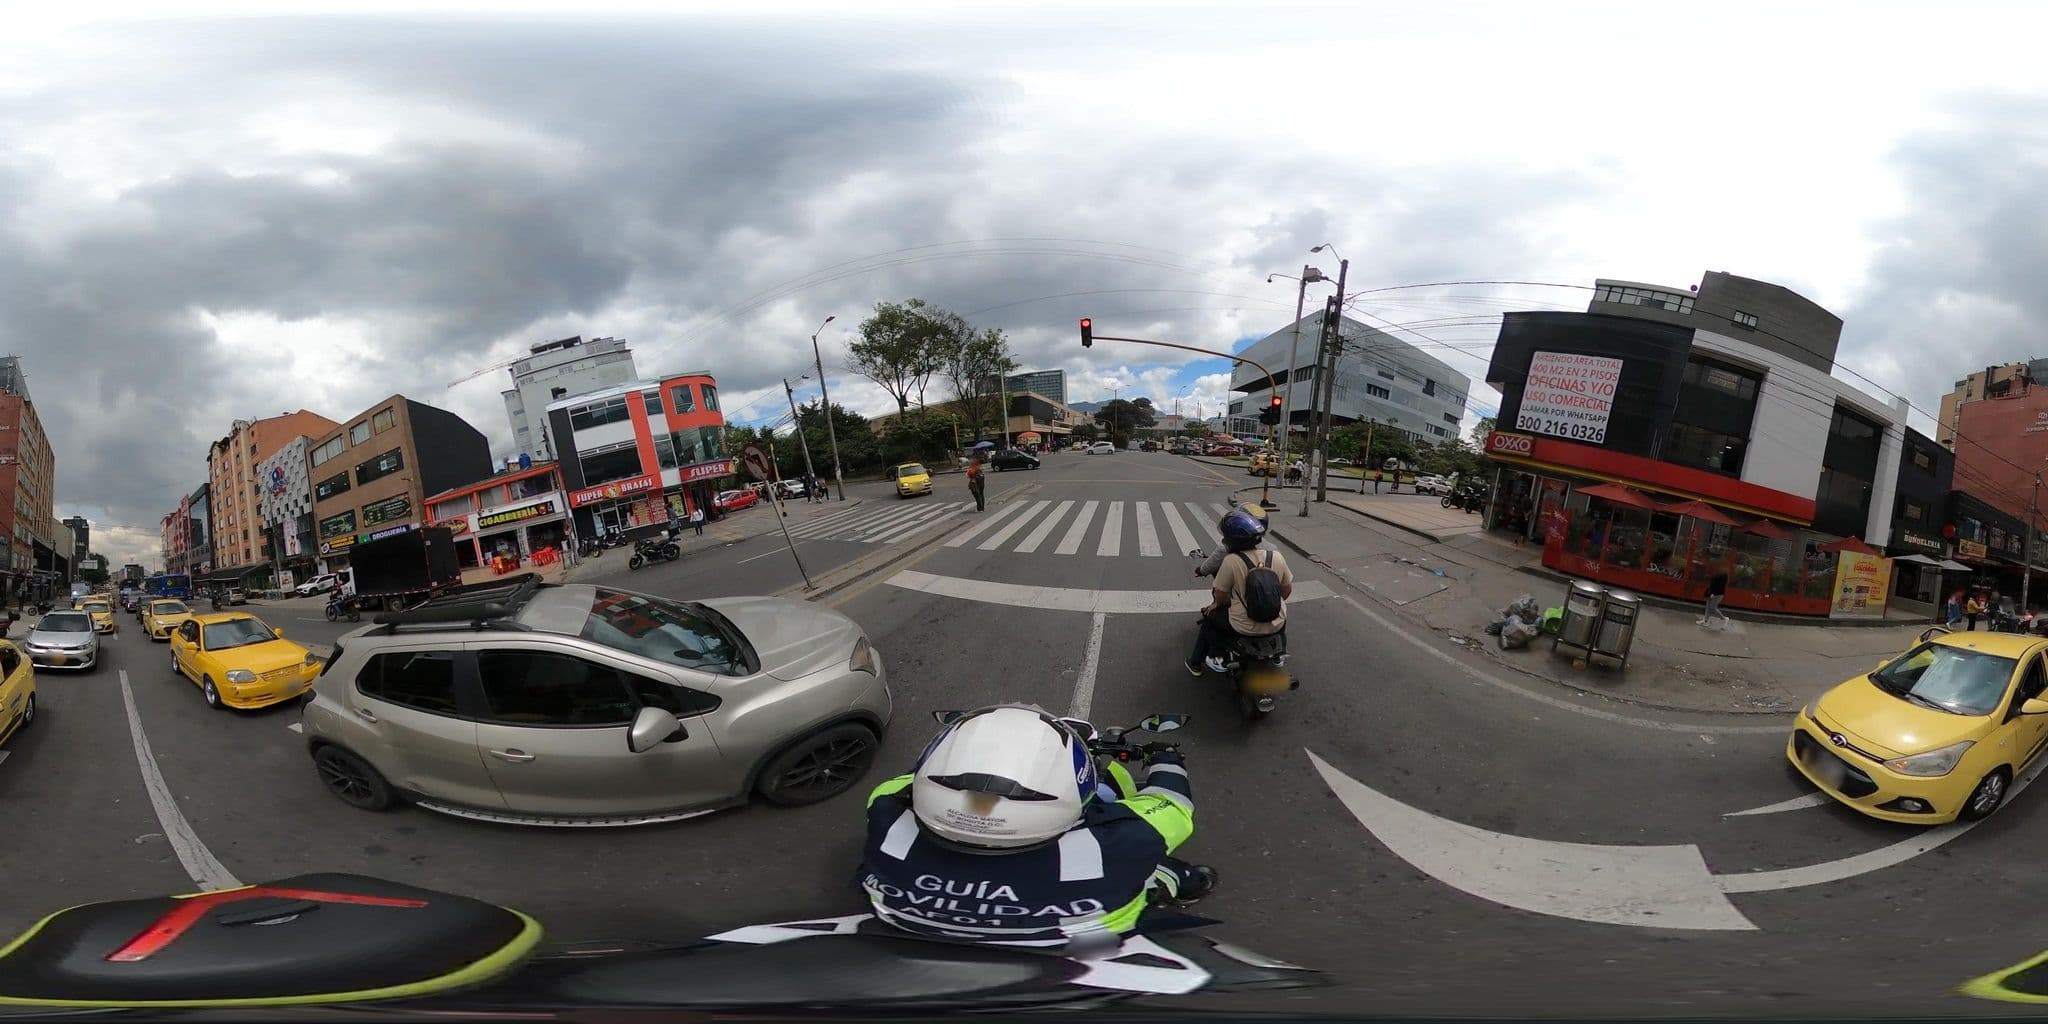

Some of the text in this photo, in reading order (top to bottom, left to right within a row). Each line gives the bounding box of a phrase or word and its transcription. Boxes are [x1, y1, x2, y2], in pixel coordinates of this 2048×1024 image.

[1566, 367, 1579, 377] EN
[1580, 368, 1588, 378] 2
[1589, 369, 1618, 382] PISOS
[1528, 375, 1614, 396] OFICINAS Y/O
[1525, 390, 1609, 412] USO COMERCIAL
[1550, 408, 1566, 417] POR
[1567, 410, 1607, 423] WHATSAPP
[1518, 415, 1604, 442] 300 216 0326
[1494, 436, 1530, 451] OXXO
[690, 463, 726, 478] SUPER
[576, 478, 653, 502] SUPER BRASAS
[863, 874, 1103, 916] MOVILIDAD
[914, 874, 1019, 902] GUÍA
